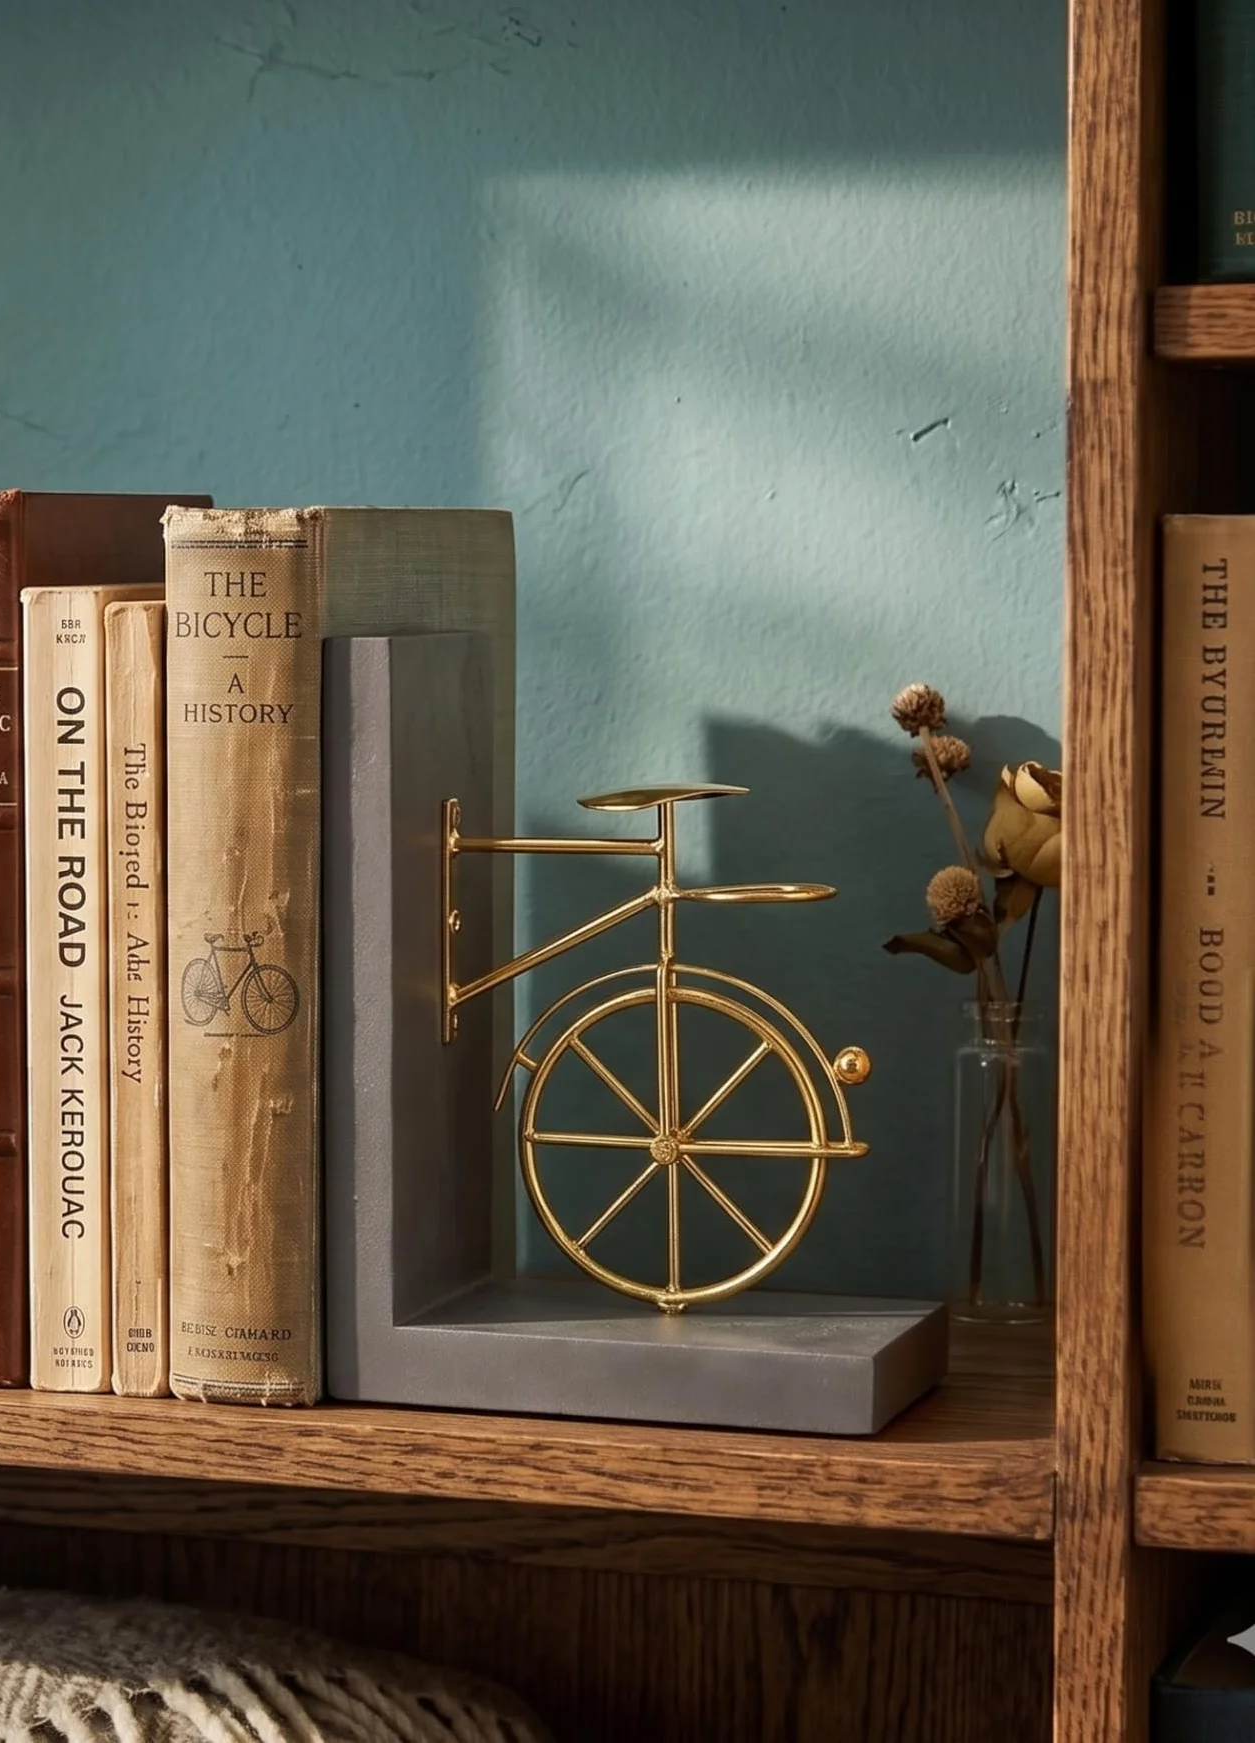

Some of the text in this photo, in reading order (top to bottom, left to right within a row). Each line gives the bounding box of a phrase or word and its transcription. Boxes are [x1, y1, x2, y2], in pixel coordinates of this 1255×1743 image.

[204, 571, 267, 598] THE
[1201, 558, 1228, 630] THE
[175, 611, 303, 639] BICYCLE
[227, 672, 245, 694] A
[183, 703, 294, 726] HISTORY
[124, 742, 147, 790] The
[56, 686, 86, 1240] ON THE ROAD JACK KEROUAC
[121, 994, 150, 1084] History
